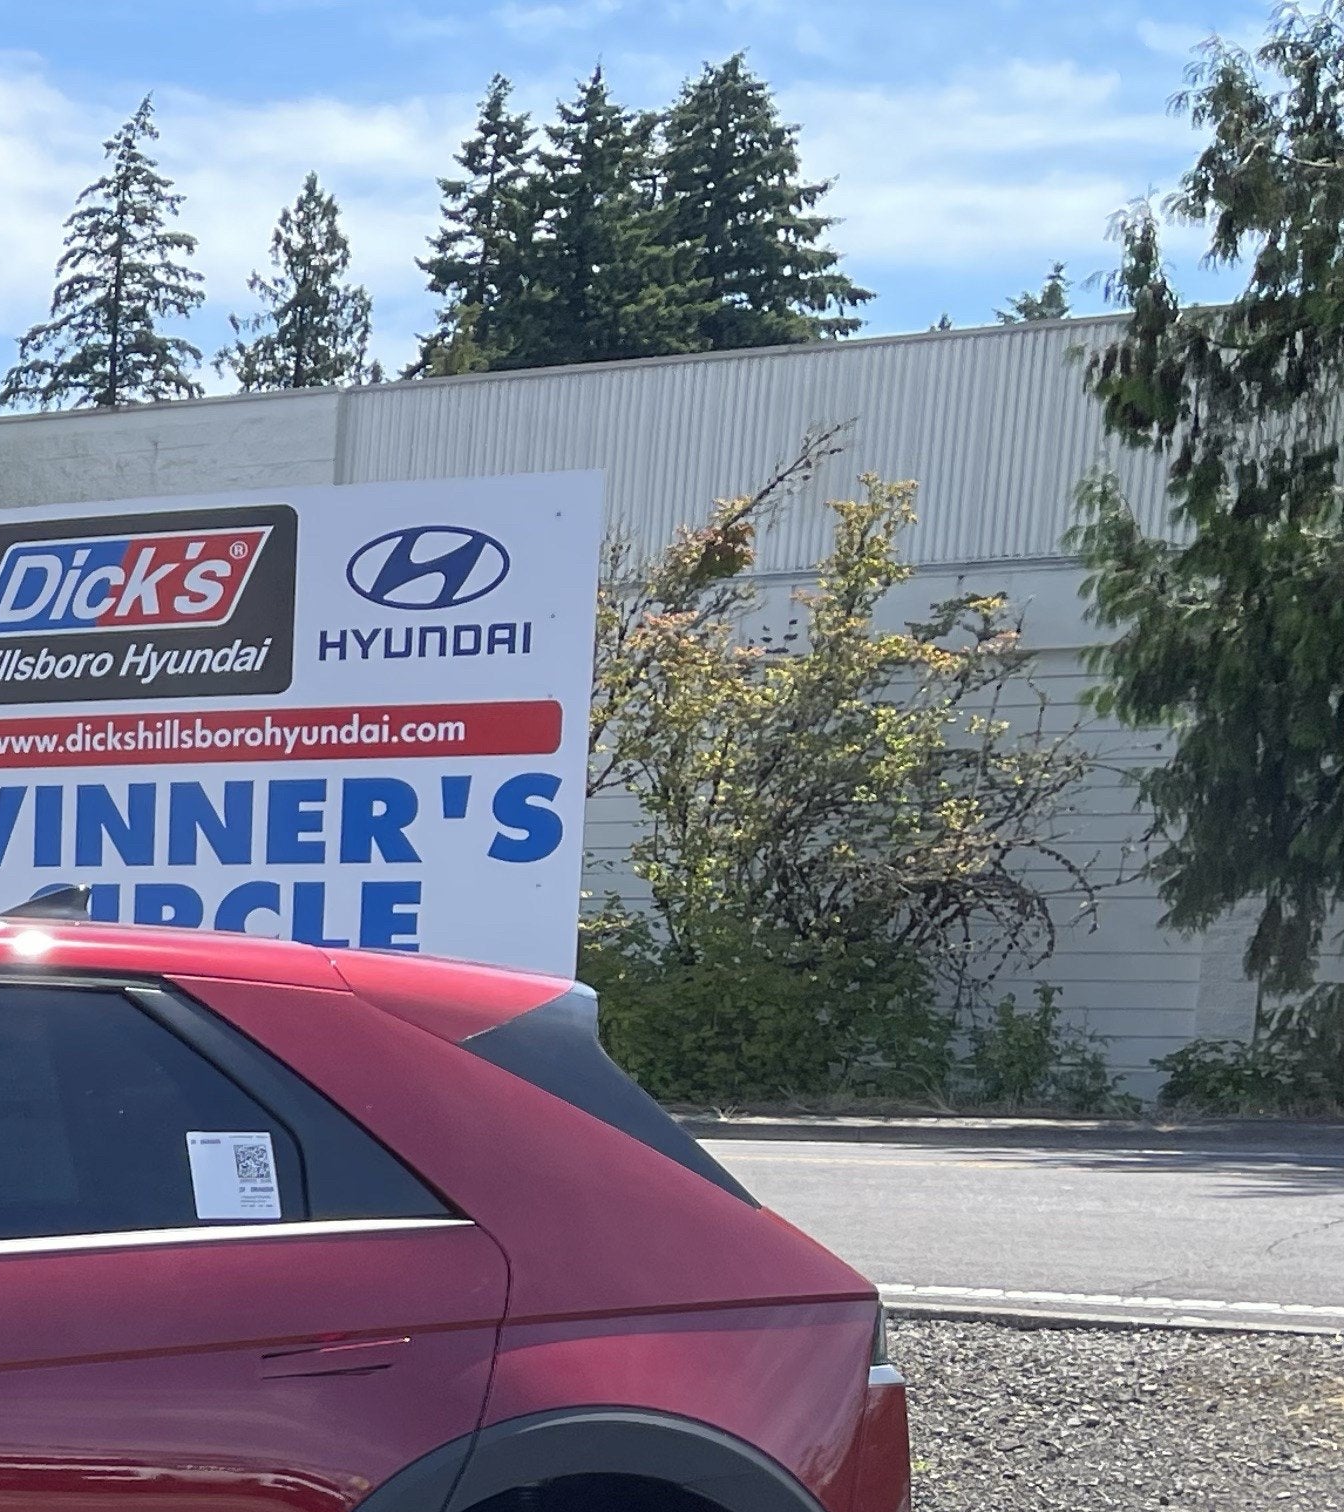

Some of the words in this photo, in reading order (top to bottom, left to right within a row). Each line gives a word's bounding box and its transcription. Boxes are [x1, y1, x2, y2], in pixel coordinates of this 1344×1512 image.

[119, 637, 273, 685] Hyundai
[318, 621, 532, 662] HYUNDAI
[30, 881, 422, 952] RCLE
